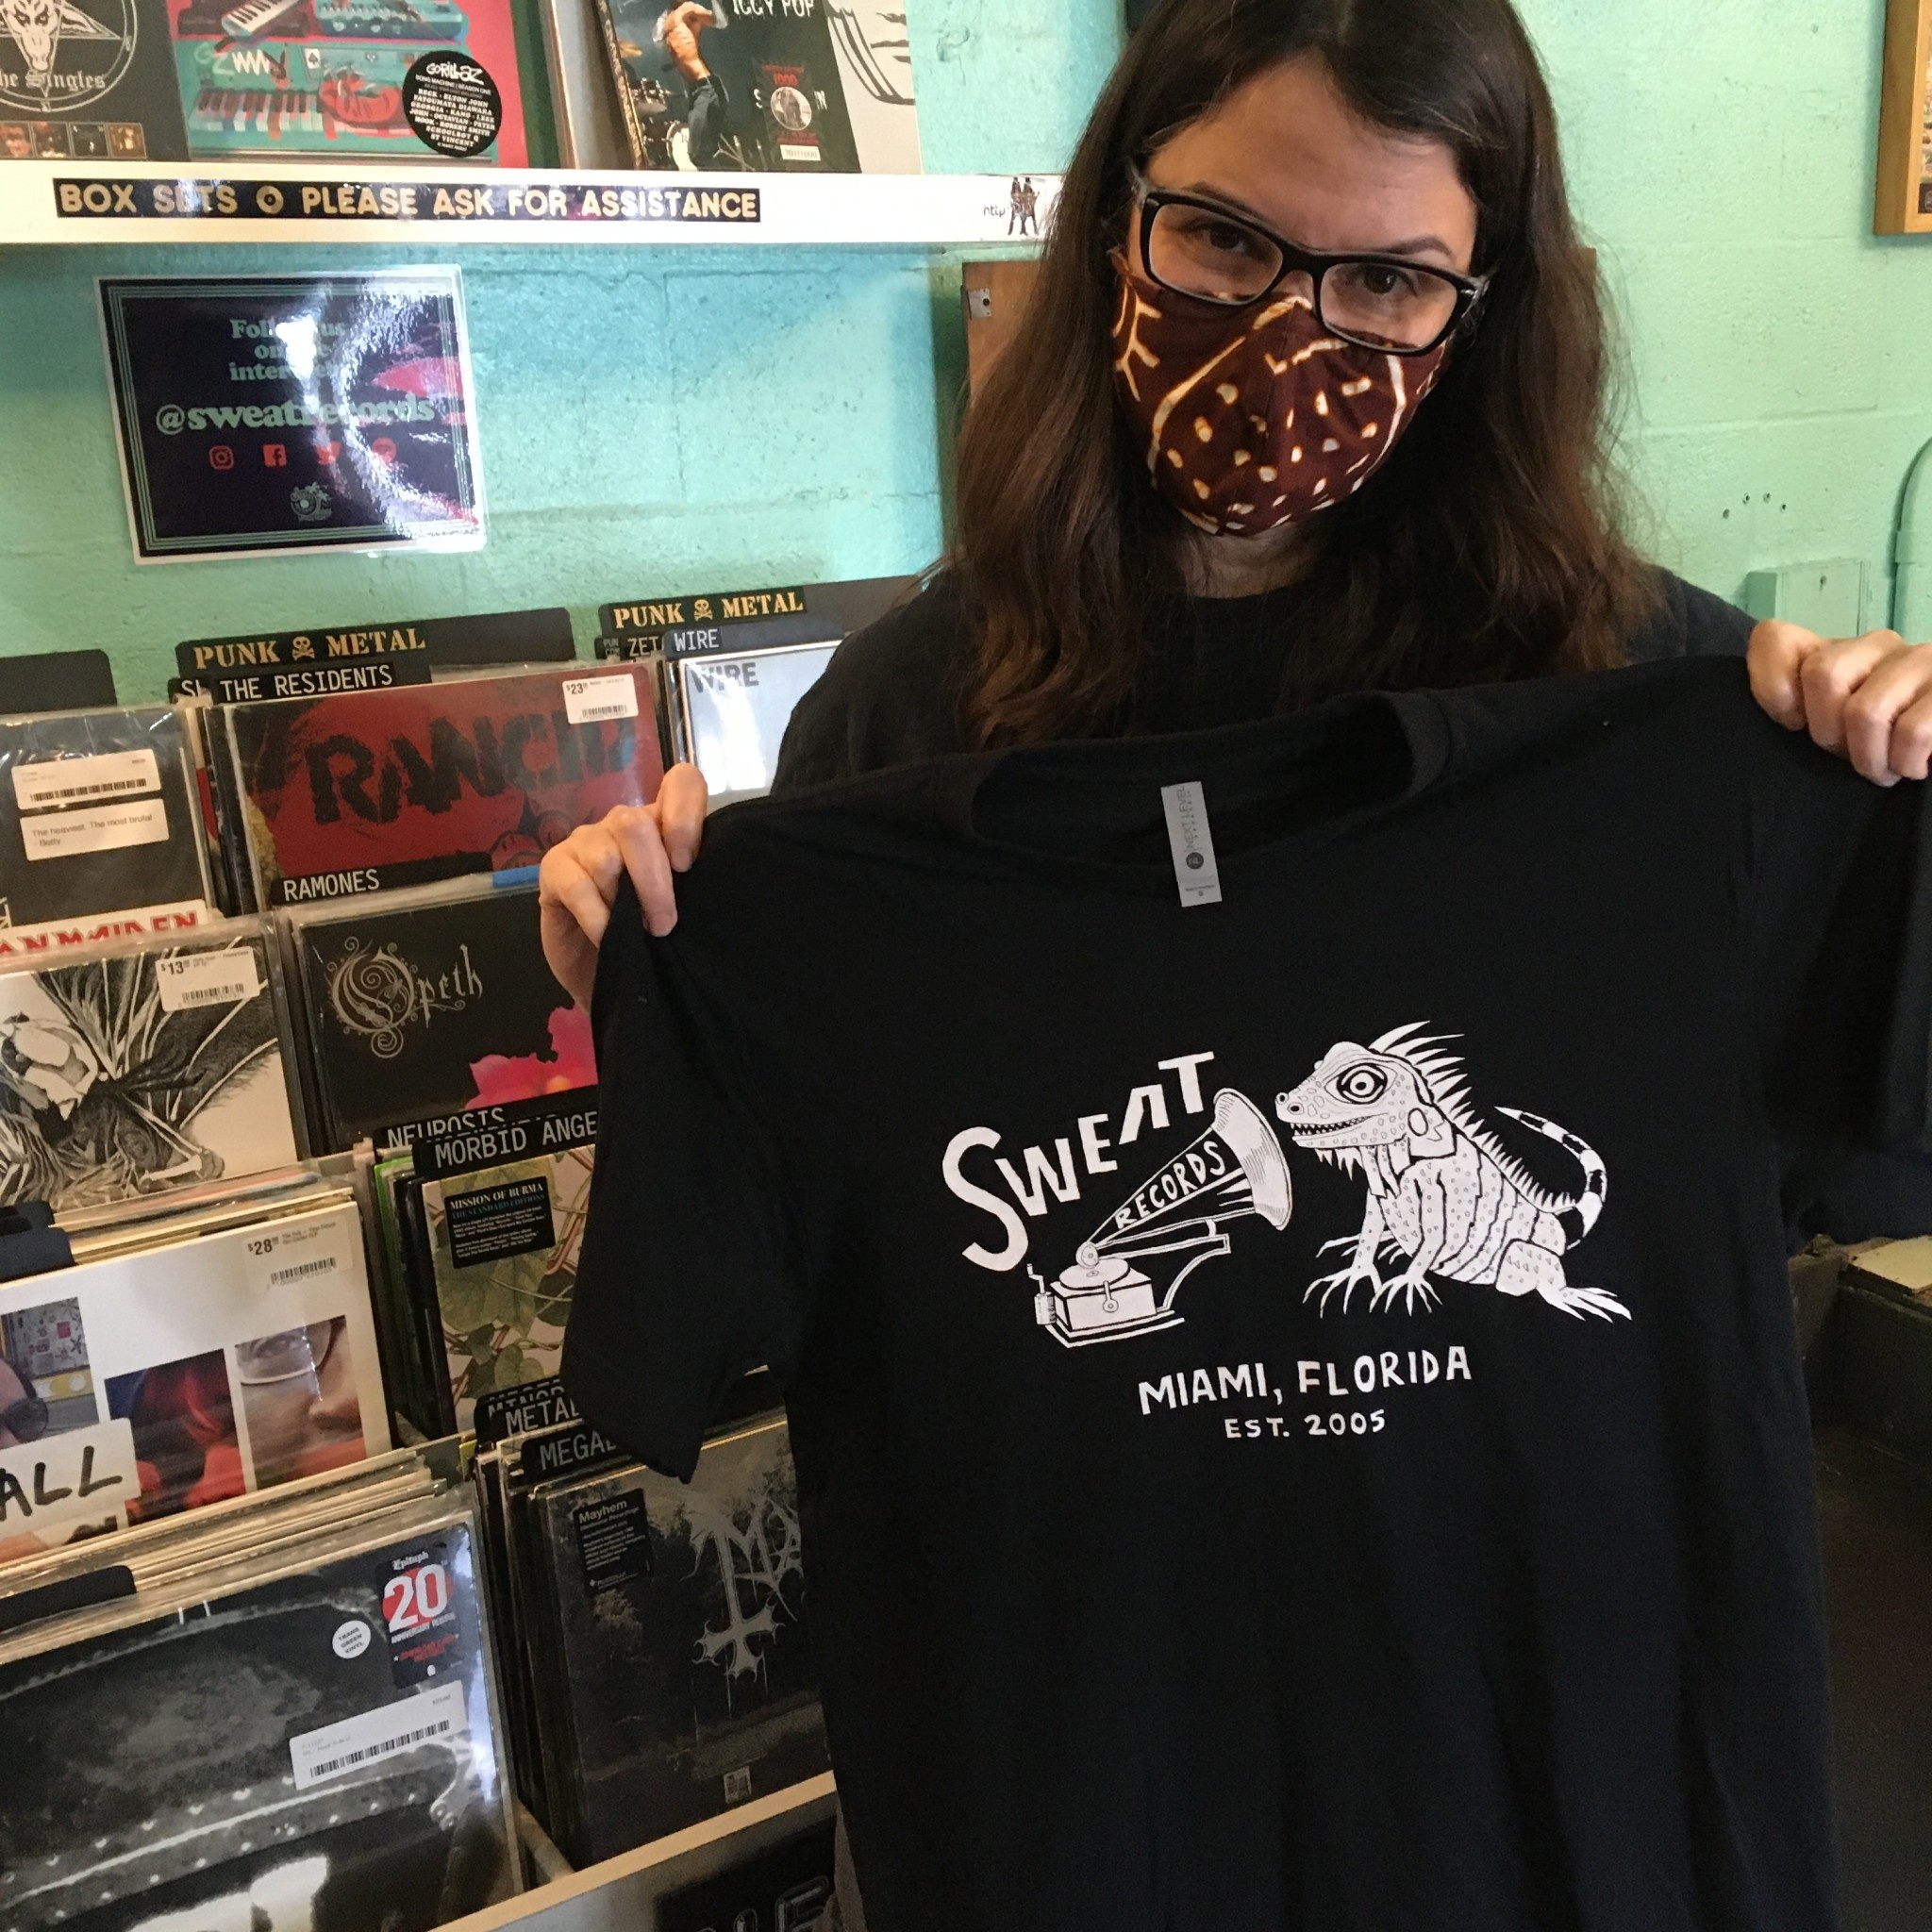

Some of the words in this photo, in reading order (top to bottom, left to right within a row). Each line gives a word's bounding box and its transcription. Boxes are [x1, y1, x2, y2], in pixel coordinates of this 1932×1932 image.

[25, 68, 105, 92] Singles
[59, 183, 137, 213] BOX
[154, 184, 237, 214] SETS
[301, 185, 418, 216] PLEASE
[433, 188, 494, 217] ASK
[507, 191, 569, 217] FOR
[581, 190, 758, 220] ASSISTANCE
[613, 601, 686, 629] PUNK
[721, 591, 804, 619] METAL
[193, 640, 281, 670] PUNK
[325, 627, 425, 658] METAL
[673, 628, 720, 652] WIRE
[220, 675, 263, 702] THE
[274, 664, 393, 697] RESIDENTS
[282, 868, 379, 902] RAMONES
[434, 1126, 527, 1169] MORBID
[542, 1111, 598, 1145] ANGE
[941, 1051, 1214, 1272] SWEAT
[450, 1192, 491, 1210] MISSION
[493, 1190, 507, 1201] OF
[508, 1183, 543, 1198] BURMA
[1114, 1140, 1226, 1229] RECORDS
[1138, 1362, 1283, 1415] MIAMI,
[1297, 1345, 1472, 1396] FLORIDA
[1224, 1417, 1290, 1439] EST.
[1304, 1408, 1386, 1436] 2005
[578, 1501, 627, 1524] Mayhem
[384, 1564, 448, 1633] 20
